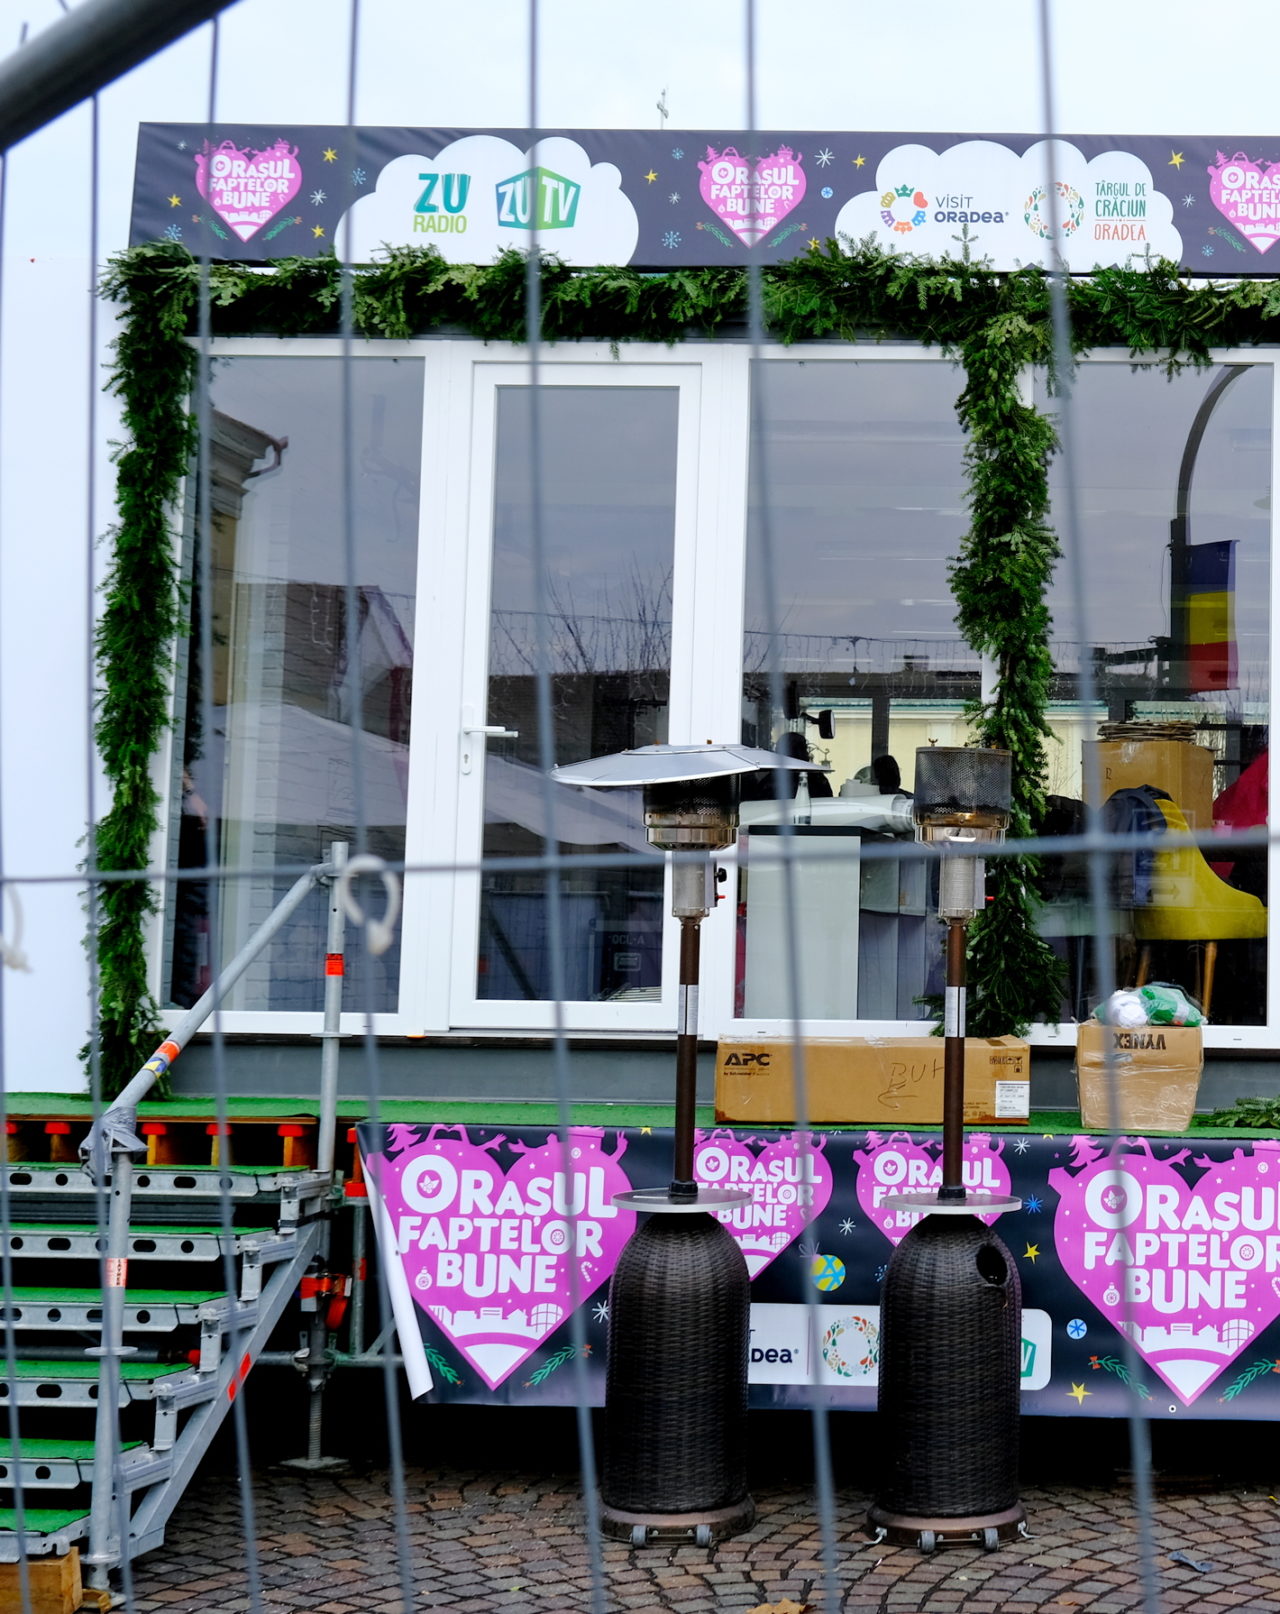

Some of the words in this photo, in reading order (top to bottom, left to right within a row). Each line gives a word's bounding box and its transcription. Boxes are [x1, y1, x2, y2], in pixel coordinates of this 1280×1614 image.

[413, 173, 471, 213] ZU
[1095, 180, 1131, 196] TÂRGUL
[1135, 182, 1146, 196] DE
[222, 191, 271, 208] BUNE
[498, 175, 531, 224] ZU
[541, 175, 577, 223] TV
[726, 198, 775, 216] BUNE
[1095, 196, 1146, 217] CRĂCIUN
[413, 215, 467, 233] RADIO
[1094, 223, 1146, 241] ORADEA
[1113, 1033, 1167, 1050] VYNEX
[724, 1053, 770, 1066] APC
[873, 1150, 1001, 1188] ORAUL
[436, 1252, 557, 1298] BUNE
[1129, 1268, 1248, 1314] BUNE
